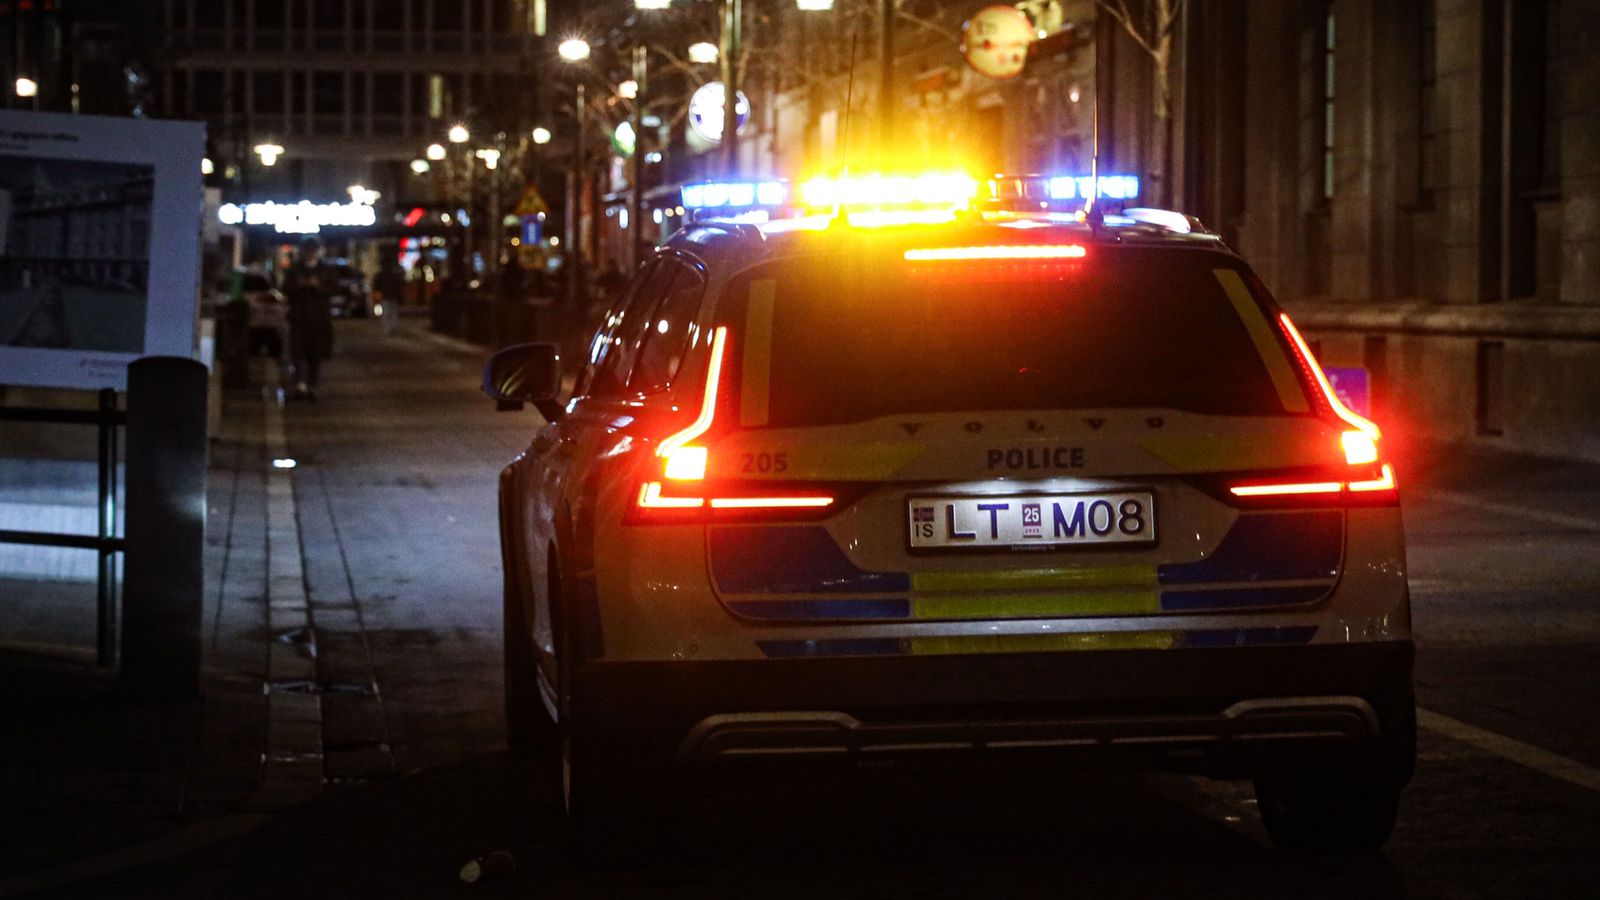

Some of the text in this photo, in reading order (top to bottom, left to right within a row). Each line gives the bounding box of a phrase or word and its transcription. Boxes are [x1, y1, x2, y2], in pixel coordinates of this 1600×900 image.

[901, 416, 1166, 434] VOLVO
[741, 452, 788, 474] 205
[987, 447, 1085, 470] POLICE
[947, 500, 1145, 539] LT M08
[1024, 507, 1040, 523] 25
[915, 523, 934, 539] IS
